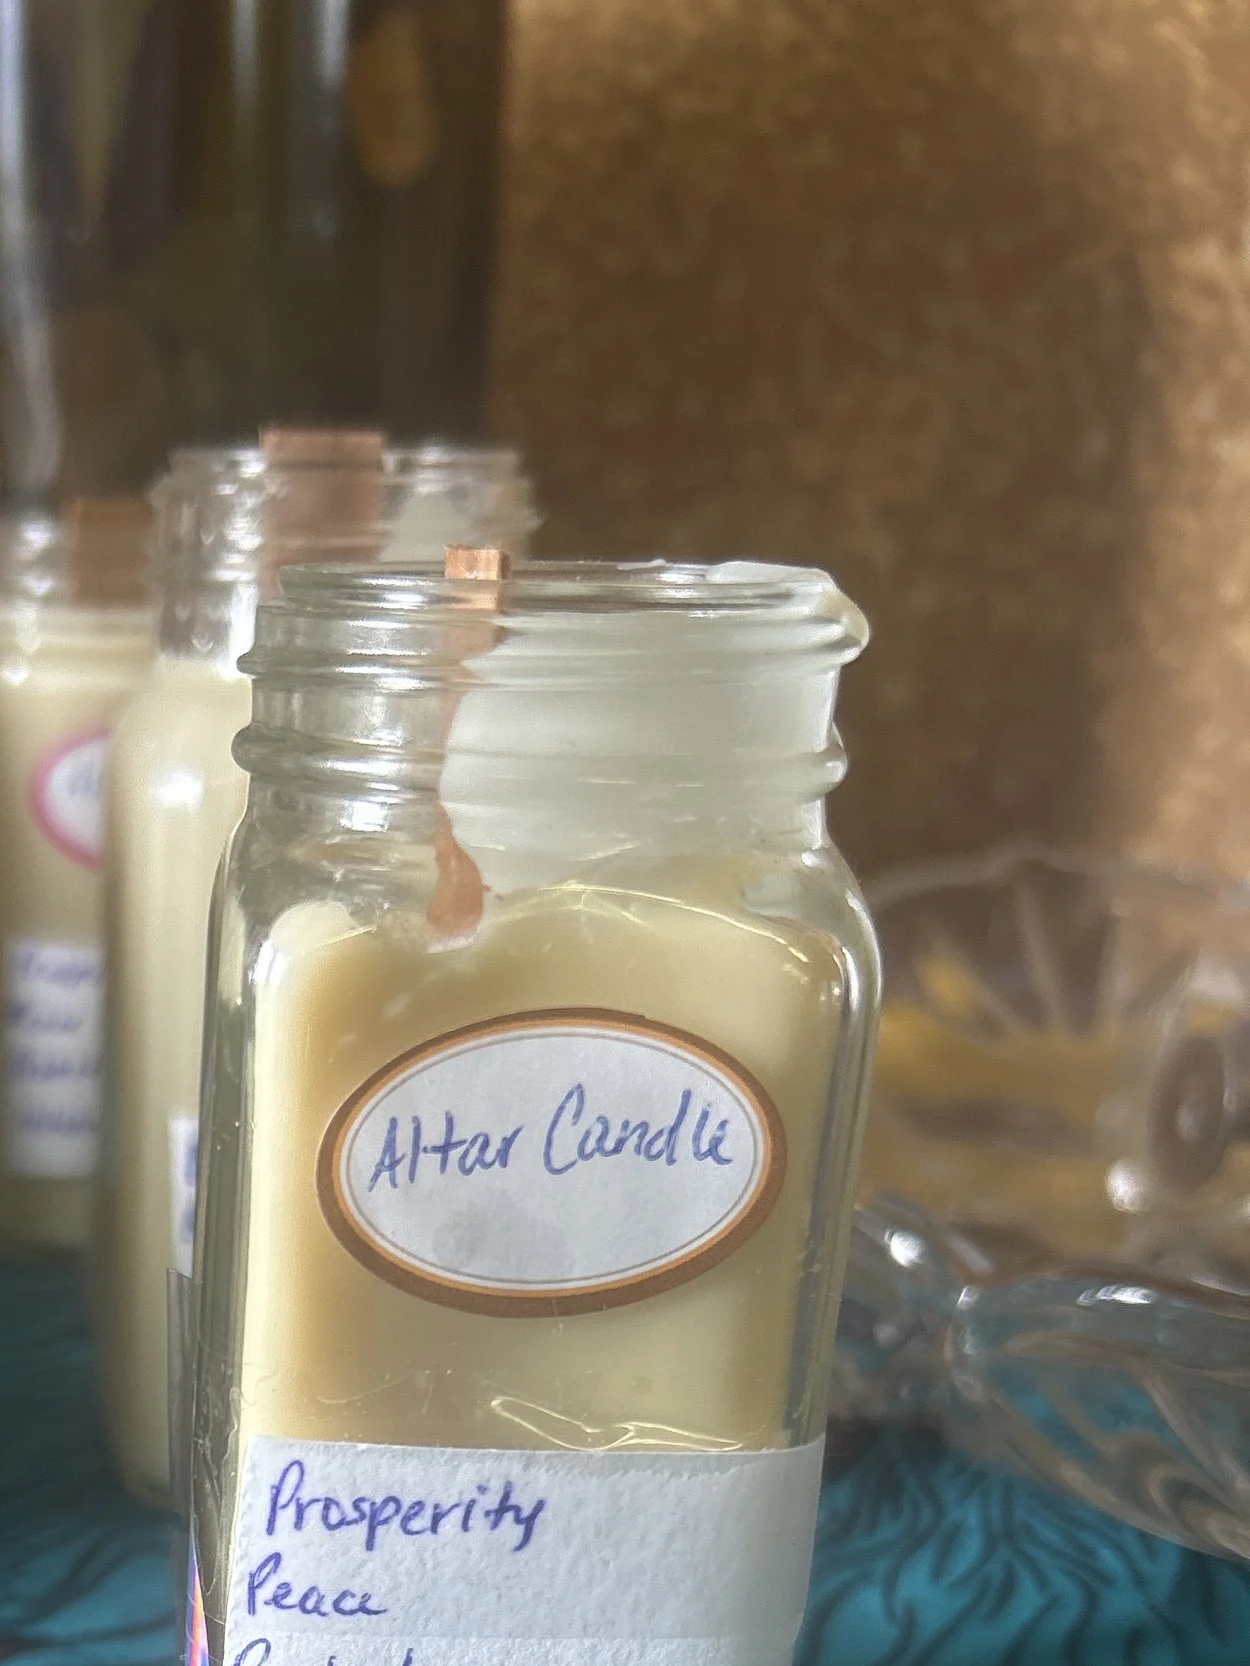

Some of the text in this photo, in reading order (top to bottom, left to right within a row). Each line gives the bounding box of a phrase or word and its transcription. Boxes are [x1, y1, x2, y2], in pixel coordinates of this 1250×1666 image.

[368, 1083, 732, 1192] Altar Candle
[266, 1459, 545, 1551] Prosperity
[247, 1551, 388, 1615] Peace
